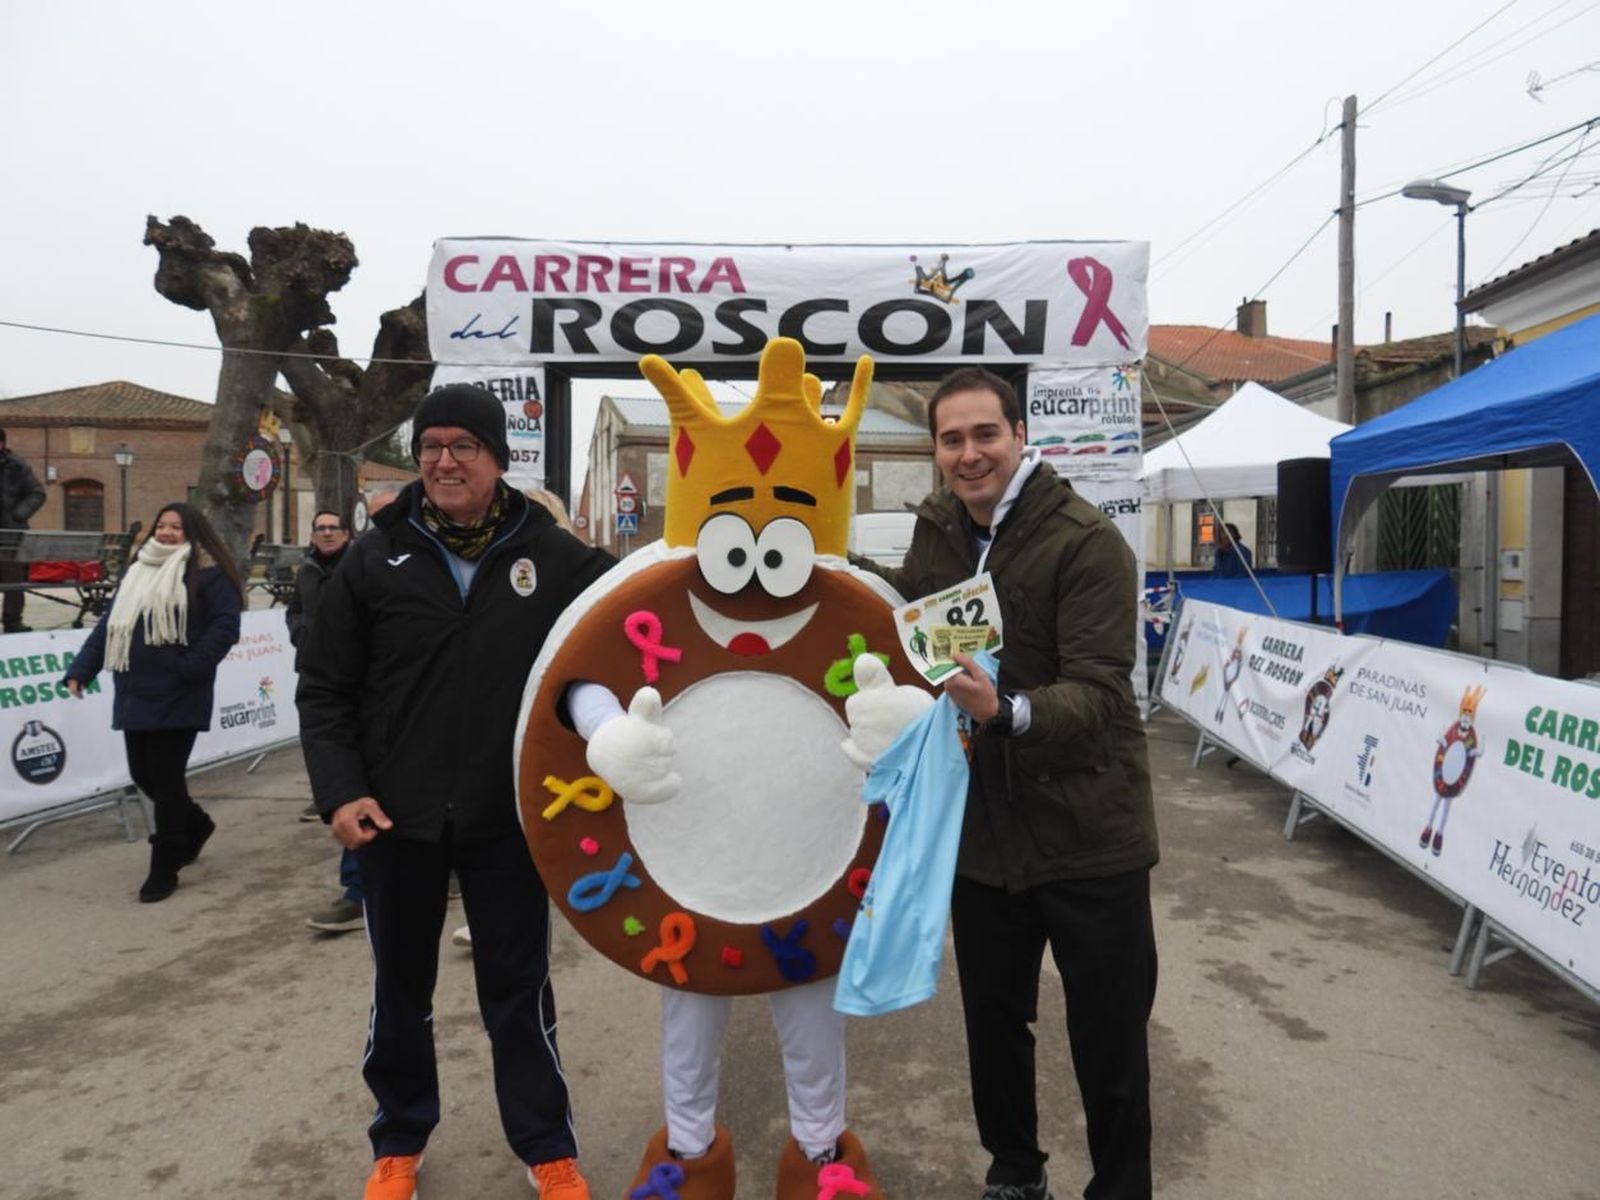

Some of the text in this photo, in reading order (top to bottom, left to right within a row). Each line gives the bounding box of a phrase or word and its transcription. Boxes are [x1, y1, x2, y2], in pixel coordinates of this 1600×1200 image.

[443, 254, 747, 294] CARRERA
[450, 313, 520, 341] del
[1030, 393, 1137, 419] eucarprint
[1033, 384, 1083, 399] imprenta
[1261, 635, 1304, 664] CARRERA
[1357, 667, 1428, 699] PARADINAS
[1350, 681, 1428, 719] DE SAN JUAN
[1504, 738, 1545, 779] DEL
